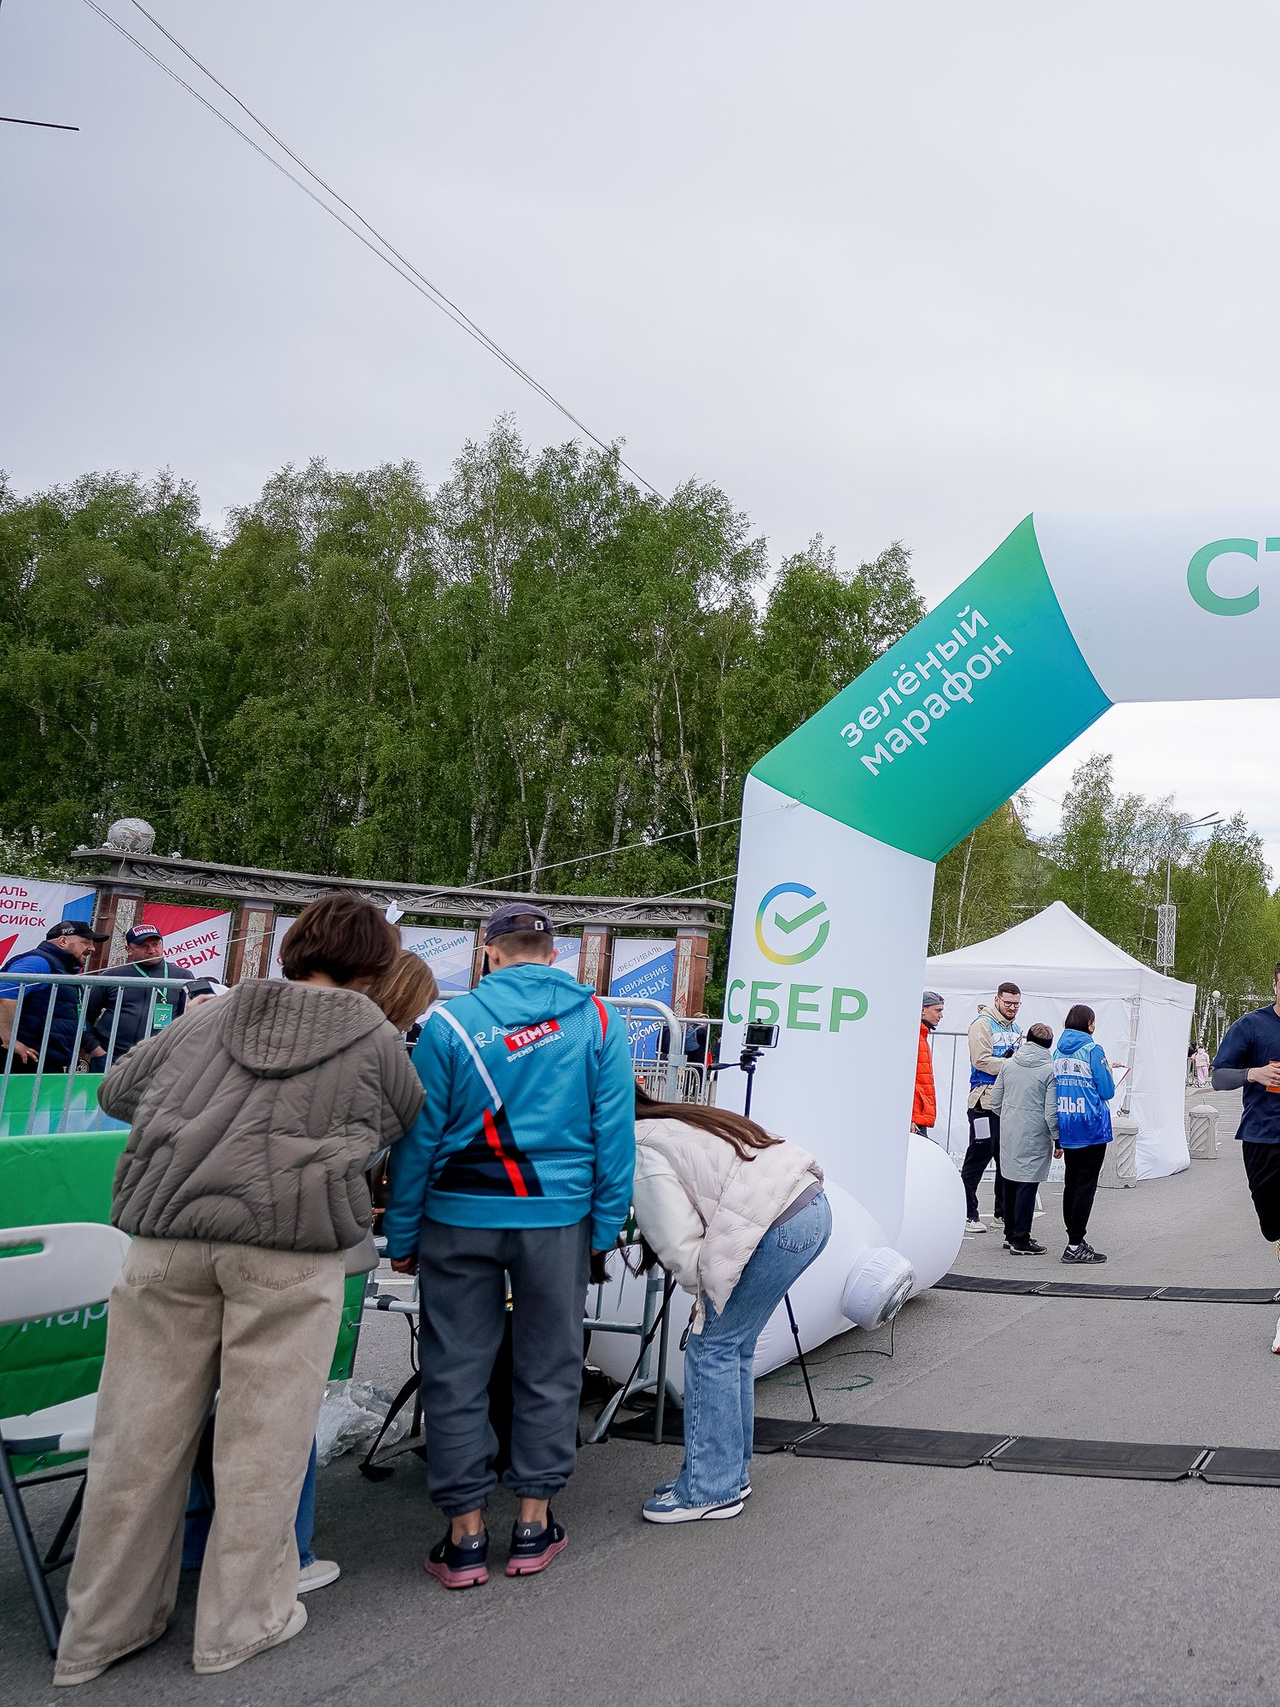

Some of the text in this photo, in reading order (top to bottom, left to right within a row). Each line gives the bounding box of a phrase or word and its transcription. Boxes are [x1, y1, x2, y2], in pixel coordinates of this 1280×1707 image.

[840, 605, 989, 747] зелёный
[860, 635, 1014, 777] марафон
[163, 930, 221, 959] ИЖЕНИЕ
[171, 945, 222, 969] ВЫХ
[617, 946, 662, 972] ФЕСТИВАЛЬ
[618, 964, 669, 997] ДВИЖЕНИЕ
[727, 979, 868, 1032] СБЕР
[511, 1021, 553, 1047] TIME
[1058, 1096, 1085, 1115] ДЬЯ
